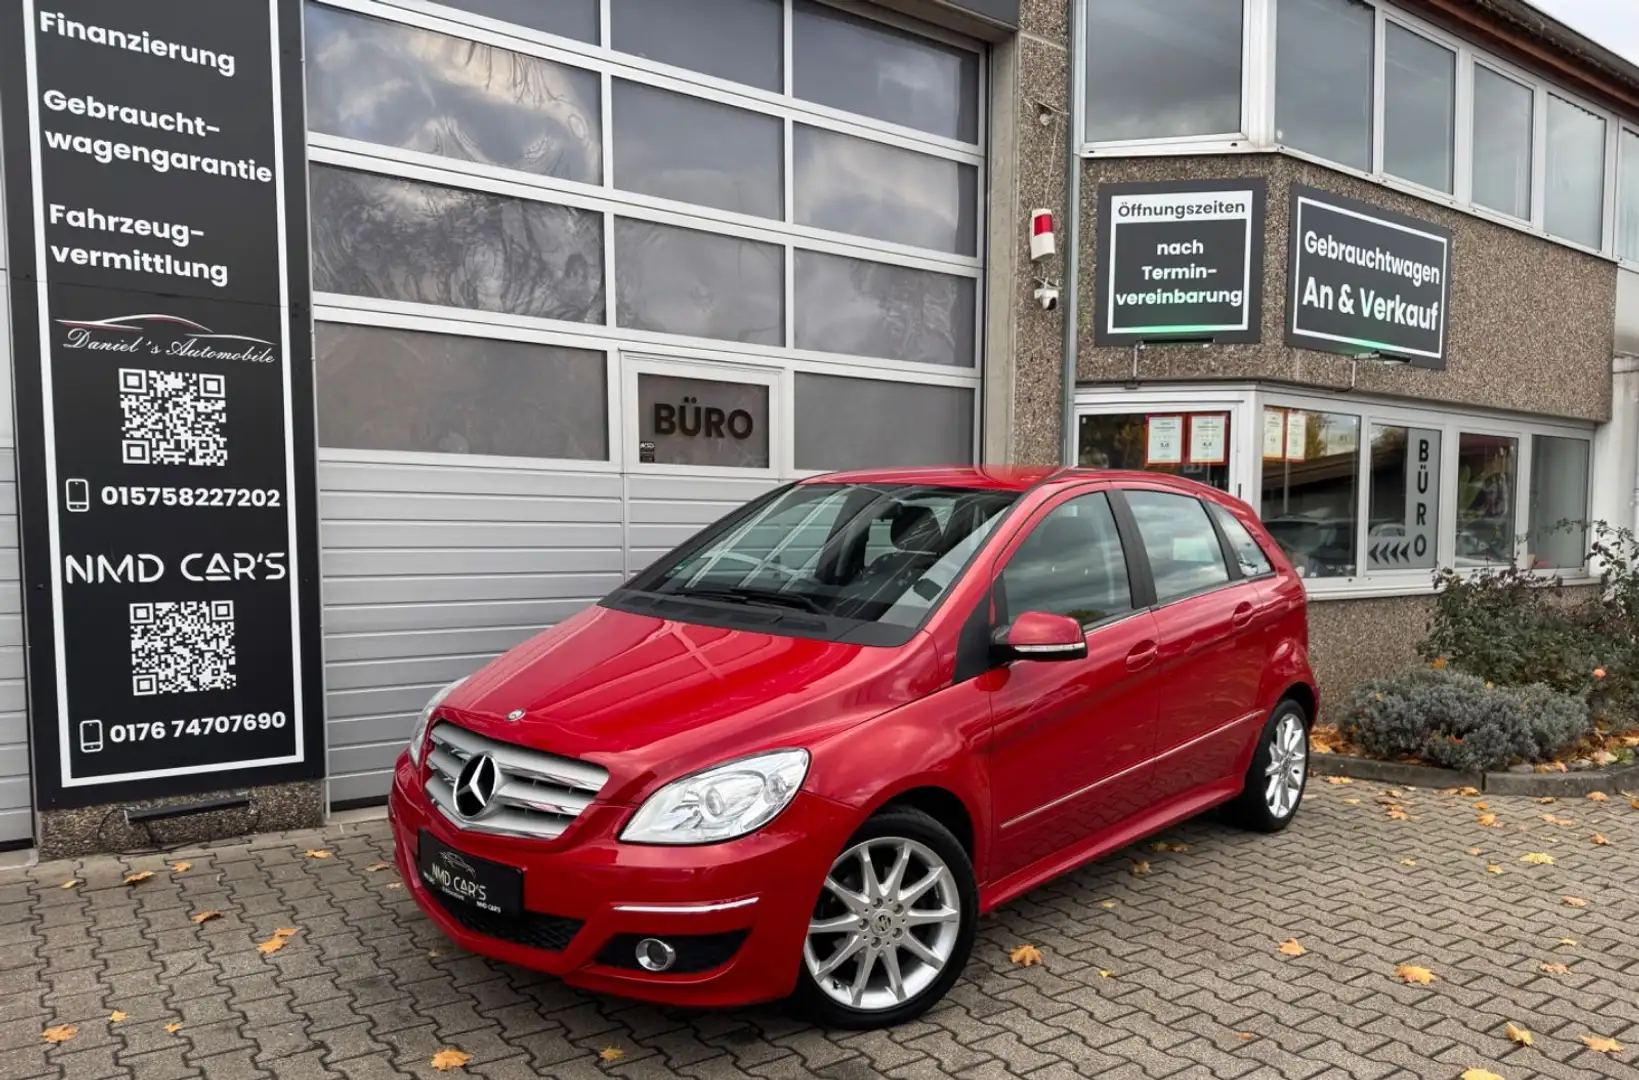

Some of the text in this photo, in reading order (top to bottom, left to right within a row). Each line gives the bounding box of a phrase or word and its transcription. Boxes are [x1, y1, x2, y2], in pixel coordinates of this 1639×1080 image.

[39, 11, 236, 77] Finanzierung
[43, 89, 221, 138] Gebraucht-
[45, 129, 273, 183] wagengarantie
[50, 203, 205, 248] Fahrzeug-
[1117, 200, 1246, 220] Öffnungszeiten
[51, 244, 228, 288] vermittlung
[1156, 239, 1205, 256] nach
[1304, 230, 1441, 288] Gebrauchtwagen
[1141, 264, 1218, 281] Termin-
[1115, 290, 1244, 307] vereinbarung
[1302, 276, 1439, 332] An & Verkauf
[165, 337, 276, 364] Automobile
[654, 396, 754, 440] BÜRO
[101, 485, 282, 508] 015758227202
[1413, 438, 1430, 558] BÜRO
[65, 552, 286, 585] NMD CAR'S
[109, 710, 287, 743] 0176 74707690
[431, 862, 451, 886] NMD
[453, 876, 487, 901] CAR'S
